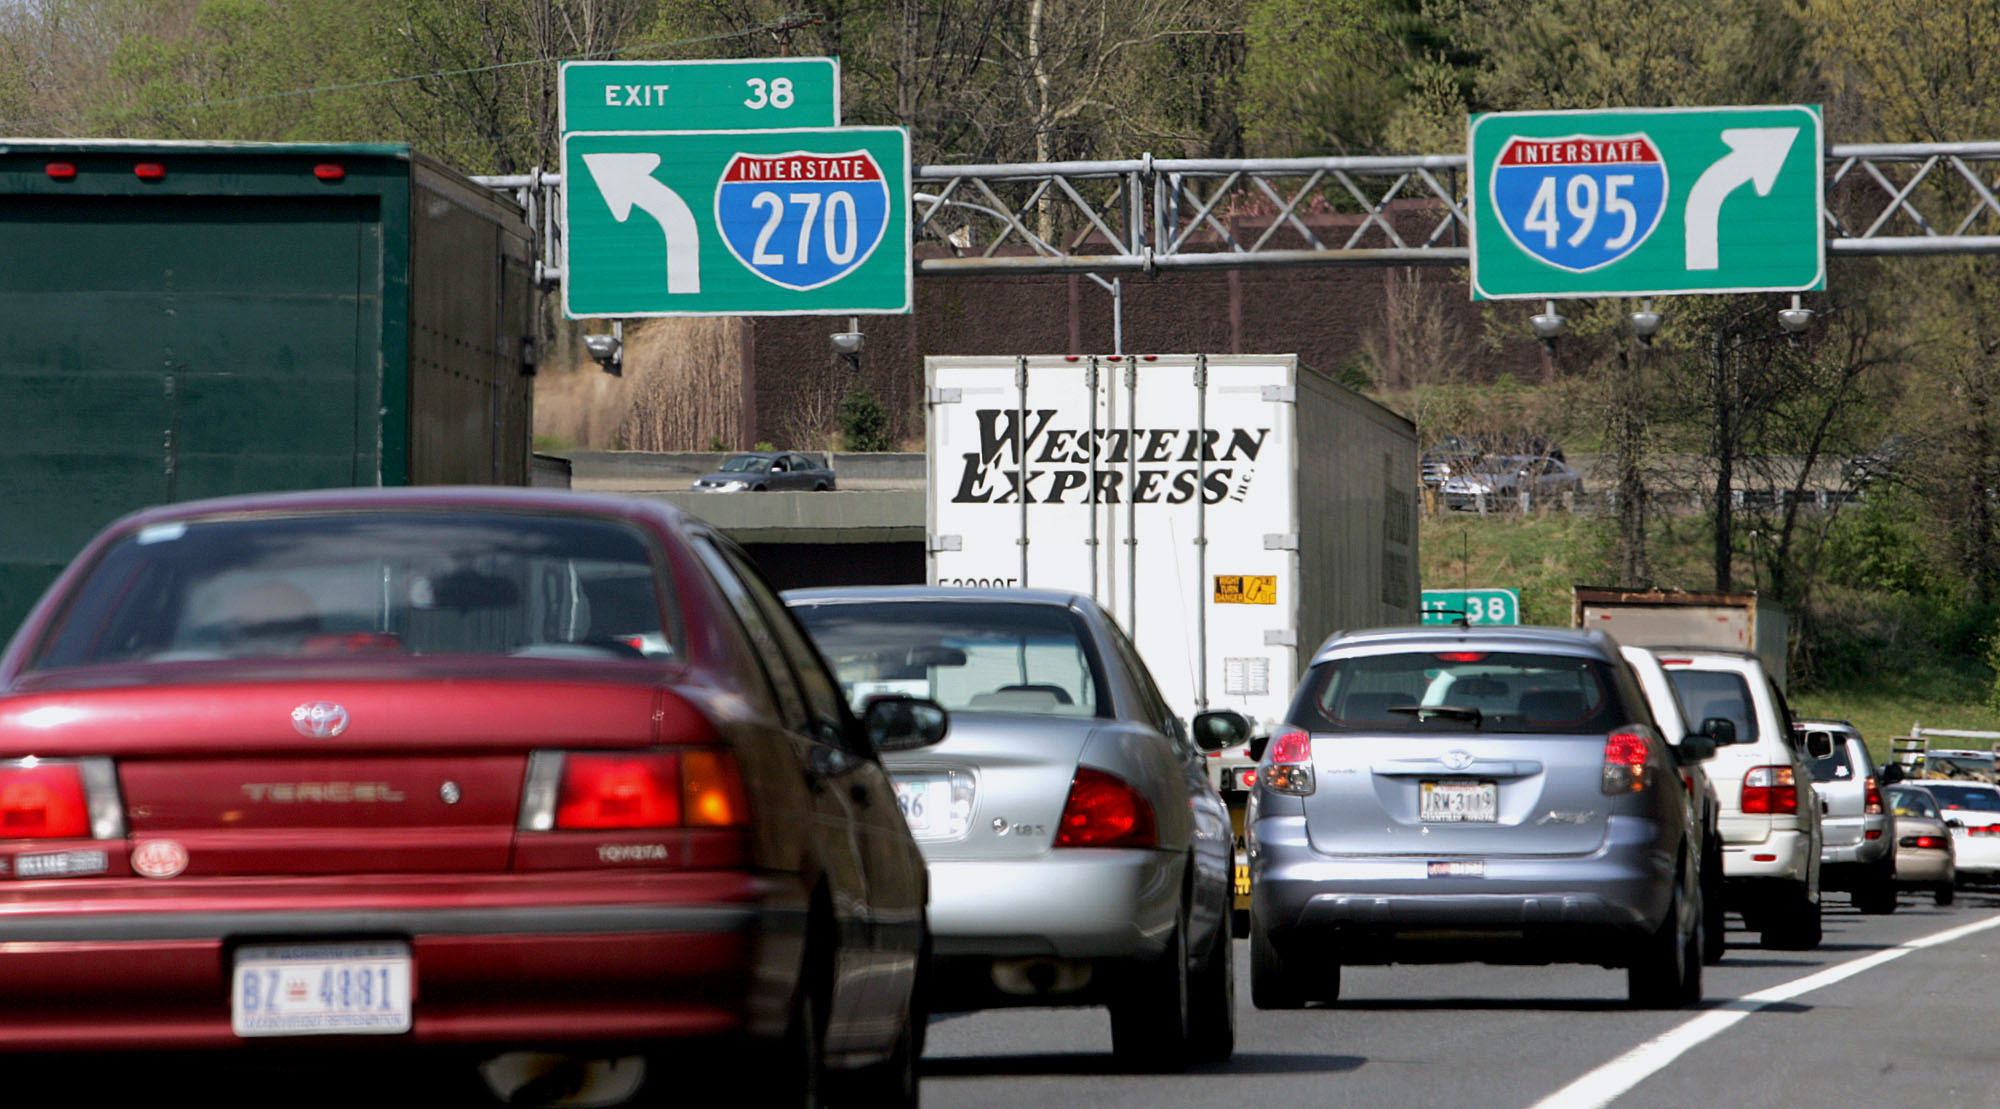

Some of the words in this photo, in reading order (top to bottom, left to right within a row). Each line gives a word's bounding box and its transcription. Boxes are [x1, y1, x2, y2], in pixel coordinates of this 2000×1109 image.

[605, 84, 670, 107] EXIT
[743, 77, 795, 110] 38
[1515, 142, 1643, 162] INTERSTATE
[739, 159, 865, 180] INTERSTATE
[1524, 173, 1638, 249] 495
[751, 190, 858, 266] 270
[1466, 597, 1506, 622] 38
[241, 782, 406, 802] TERCEL
[596, 844, 668, 862] TOYOTA
